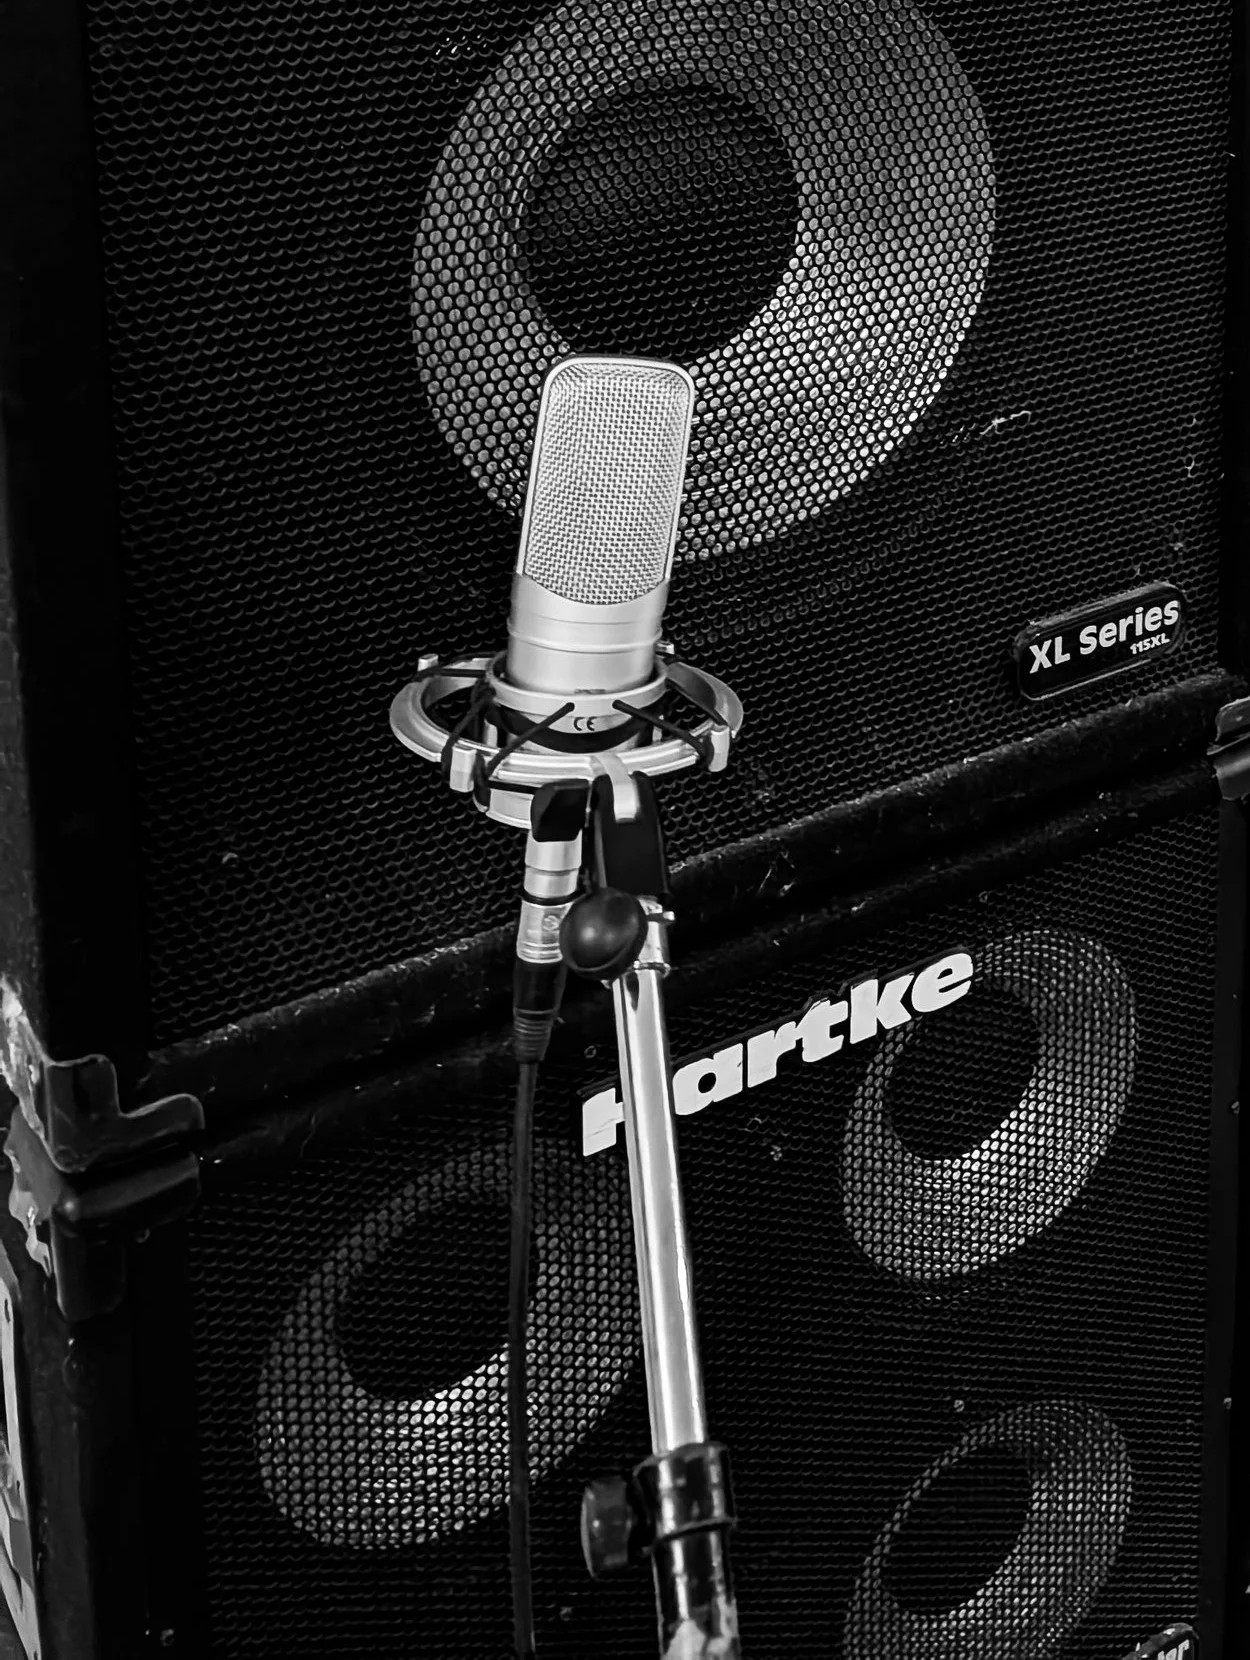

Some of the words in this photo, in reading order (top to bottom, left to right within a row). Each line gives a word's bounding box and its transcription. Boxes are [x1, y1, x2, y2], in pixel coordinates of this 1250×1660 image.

[1029, 636, 1071, 674] XL
[1079, 600, 1180, 655] Series
[1130, 633, 1171, 655] 115XL
